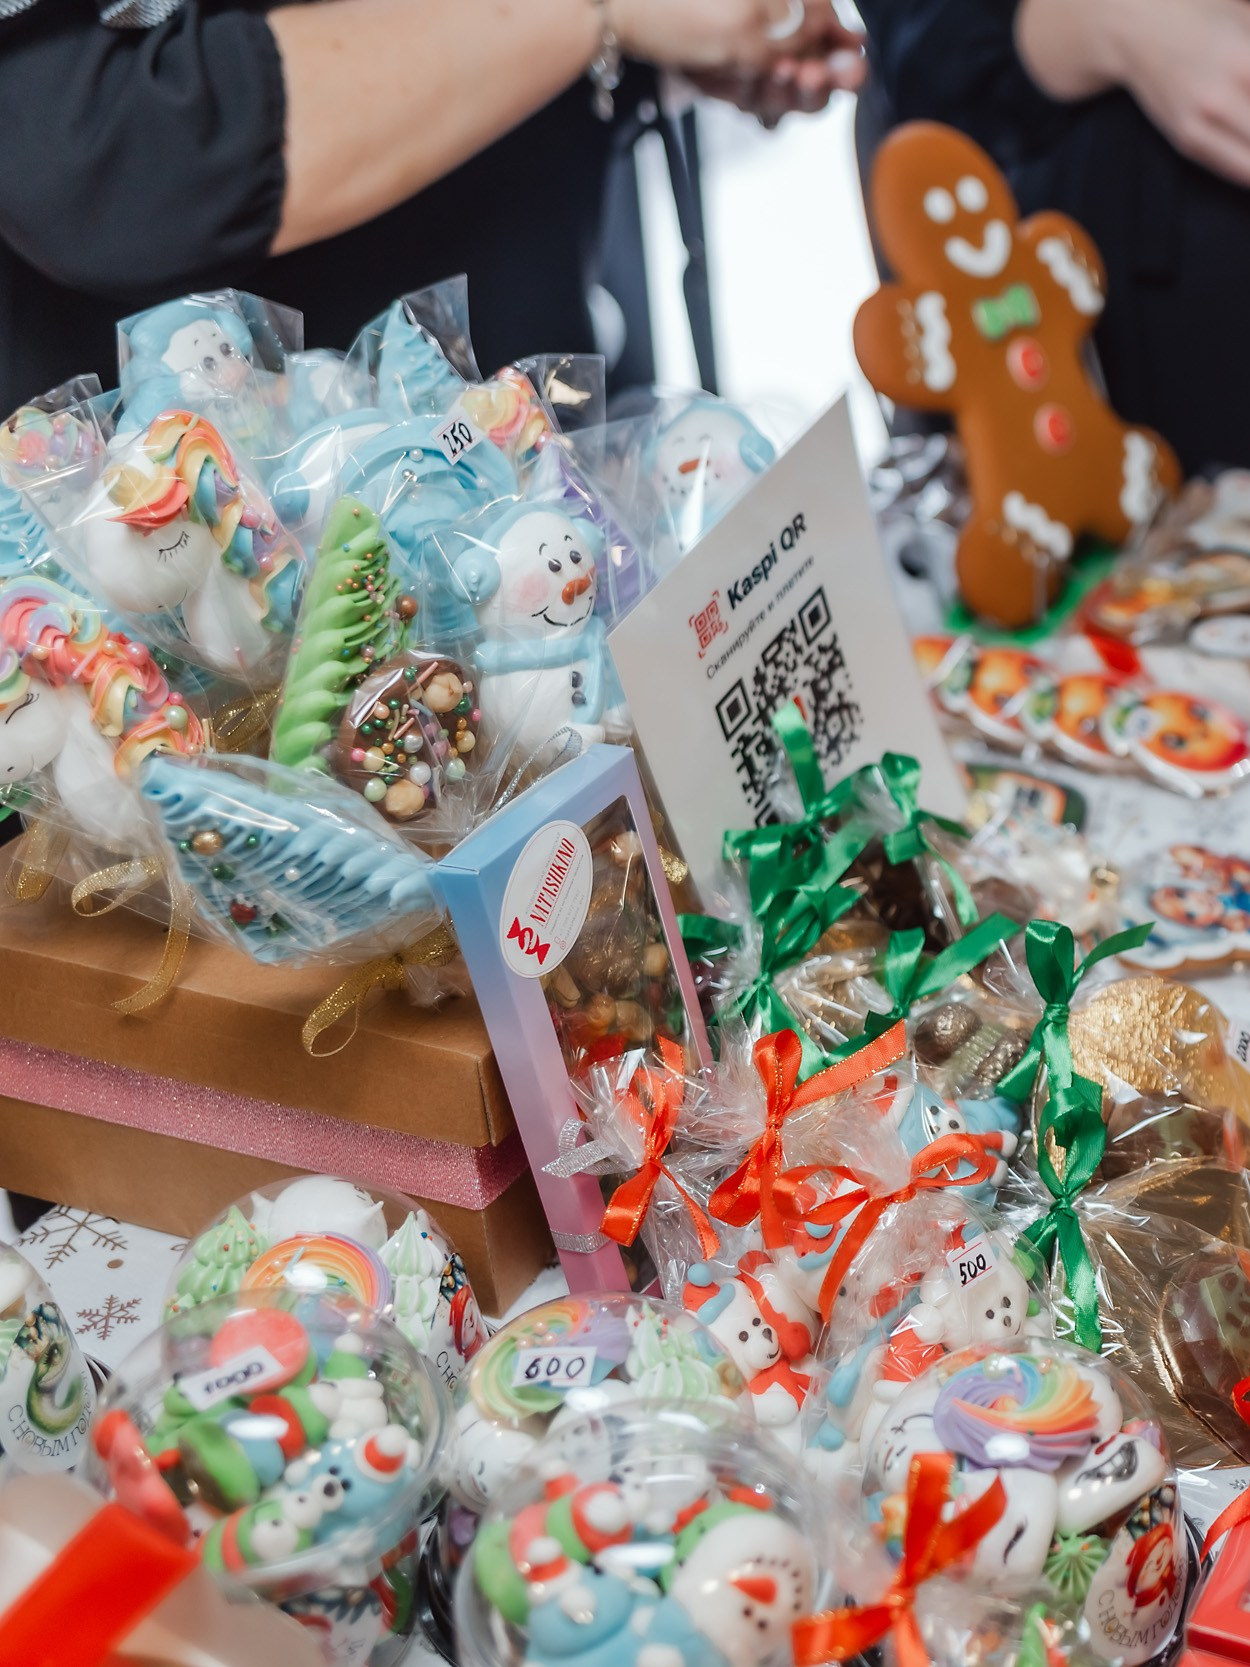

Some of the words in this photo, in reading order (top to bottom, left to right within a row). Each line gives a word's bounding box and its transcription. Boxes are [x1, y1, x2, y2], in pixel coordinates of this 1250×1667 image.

[442, 421, 473, 457] 250
[727, 542, 779, 610] Kaspi
[780, 512, 808, 552] QR
[706, 610, 767, 680] Сканируйте
[529, 837, 577, 927] NATASHKINO
[959, 1253, 987, 1285] 500
[203, 1361, 263, 1395] 1000
[524, 1356, 586, 1380] 600
[12, 1420, 70, 1457] НОВЫМ
